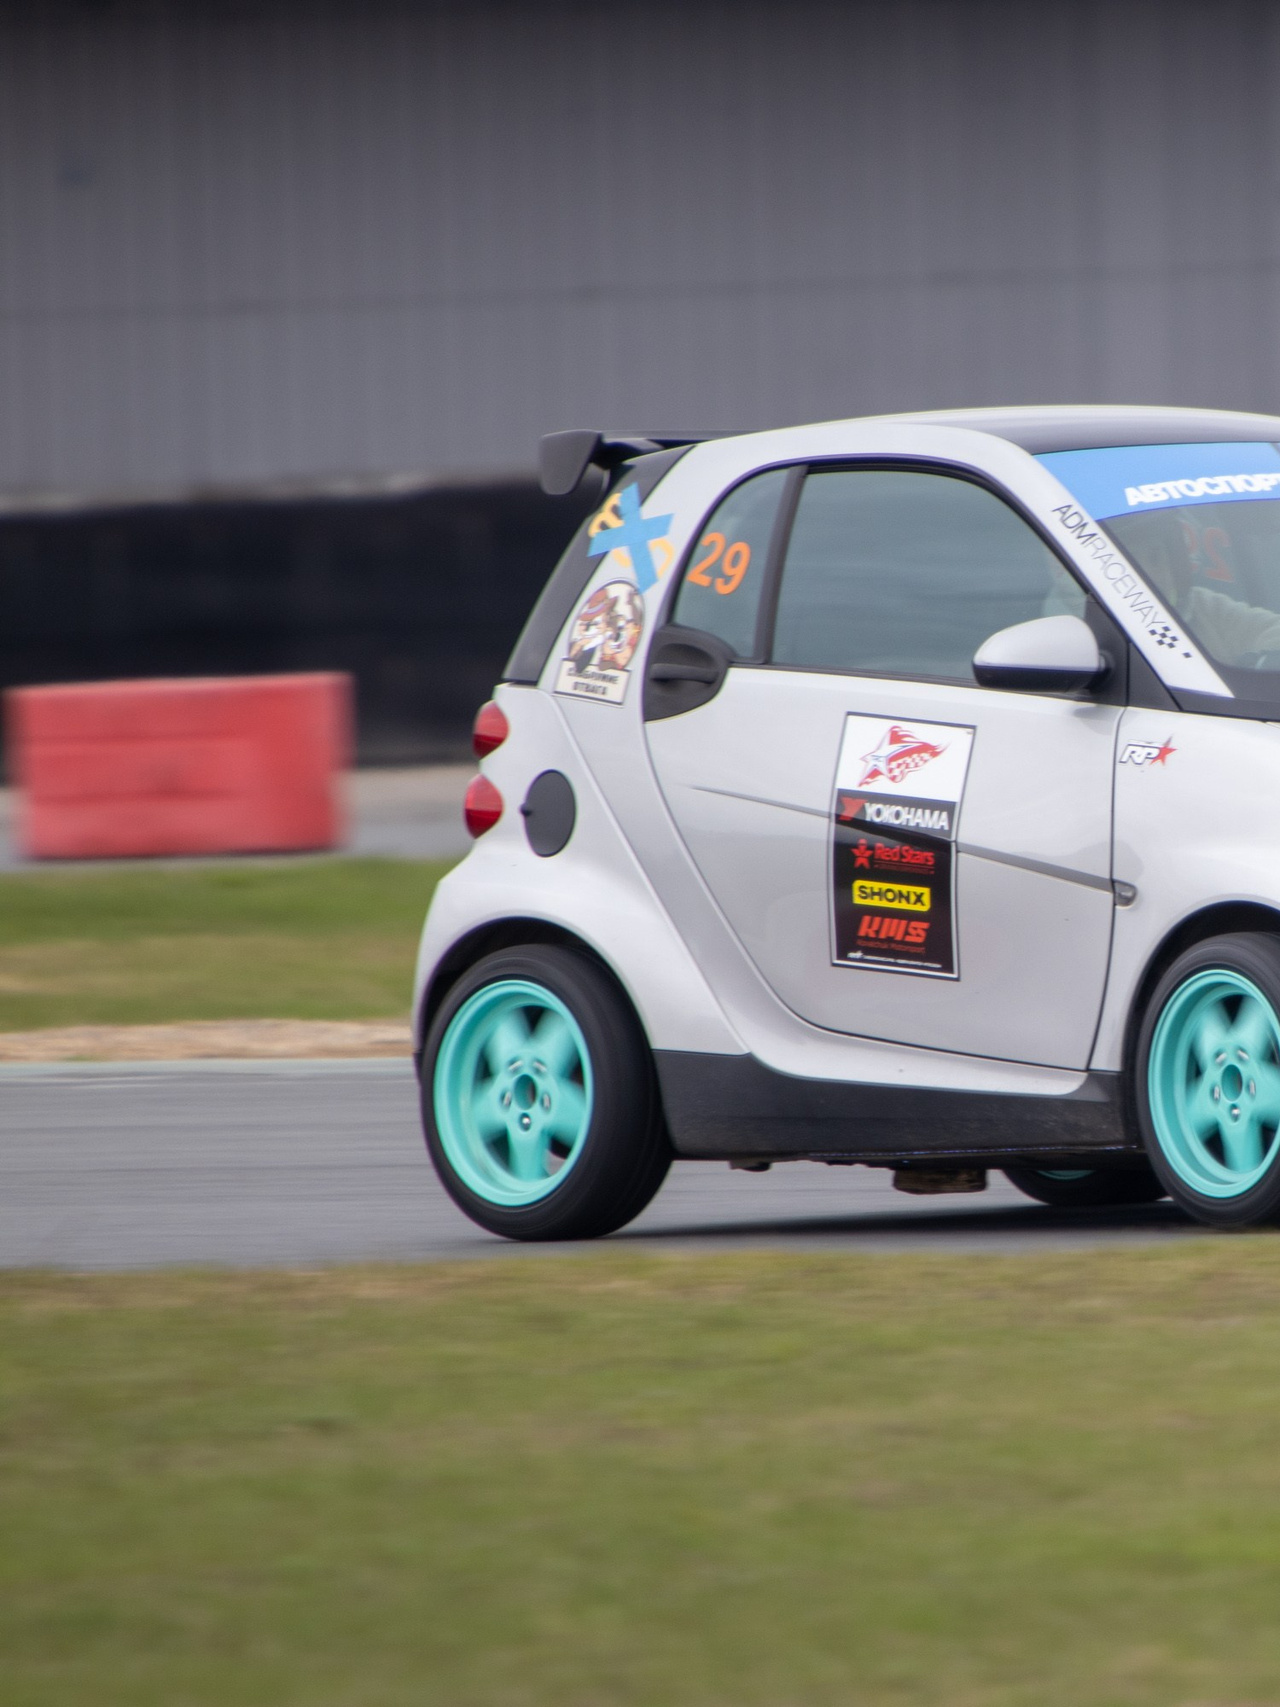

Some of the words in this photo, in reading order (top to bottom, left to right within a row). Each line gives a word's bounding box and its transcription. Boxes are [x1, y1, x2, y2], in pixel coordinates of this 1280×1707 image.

[687, 532, 751, 595] 29
[864, 802, 950, 830] YOKOHAMA
[874, 843, 900, 861] Red
[901, 845, 935, 866] Stars
[857, 885, 926, 907] SHONX
[857, 915, 930, 943] KMS
